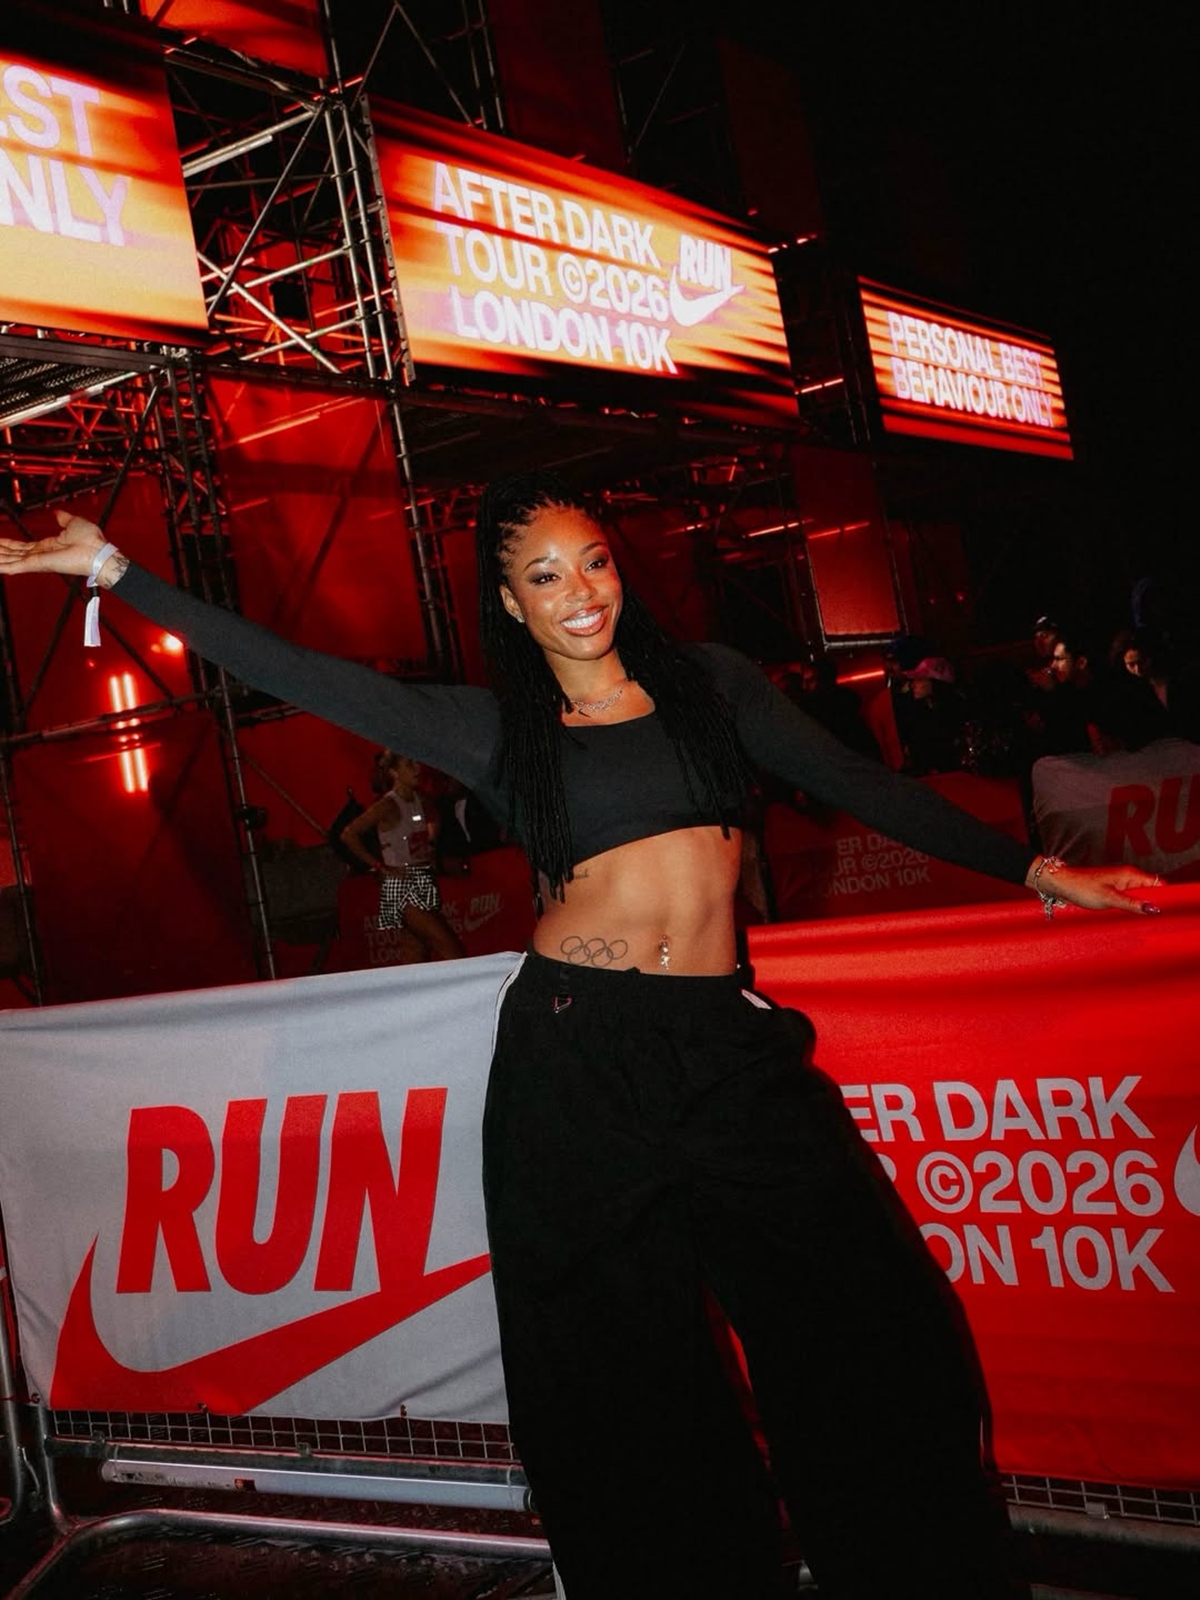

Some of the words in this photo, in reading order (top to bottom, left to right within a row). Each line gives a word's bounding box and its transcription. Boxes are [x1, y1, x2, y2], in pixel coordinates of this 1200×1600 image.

[0, 64, 100, 159] ST
[433, 160, 561, 243] AFTER
[562, 198, 662, 269] DARK
[435, 218, 553, 297] TOUR
[557, 252, 670, 323] ©2026
[678, 232, 733, 291] RUN
[451, 285, 614, 363] LONDON
[615, 319, 679, 375] 10K
[887, 311, 999, 375] PERSONAL
[999, 342, 1043, 387] BEST
[890, 356, 1011, 420] BEHAVIOUR
[1011, 388, 1054, 428] ONLY
[1102, 773, 1200, 864] RU
[894, 866, 933, 887] 10K
[933, 1075, 1156, 1142] DARK
[116, 1087, 449, 1295] RUN
[916, 1150, 1165, 1217] ©2026
[1030, 1223, 1176, 1293] 10K
